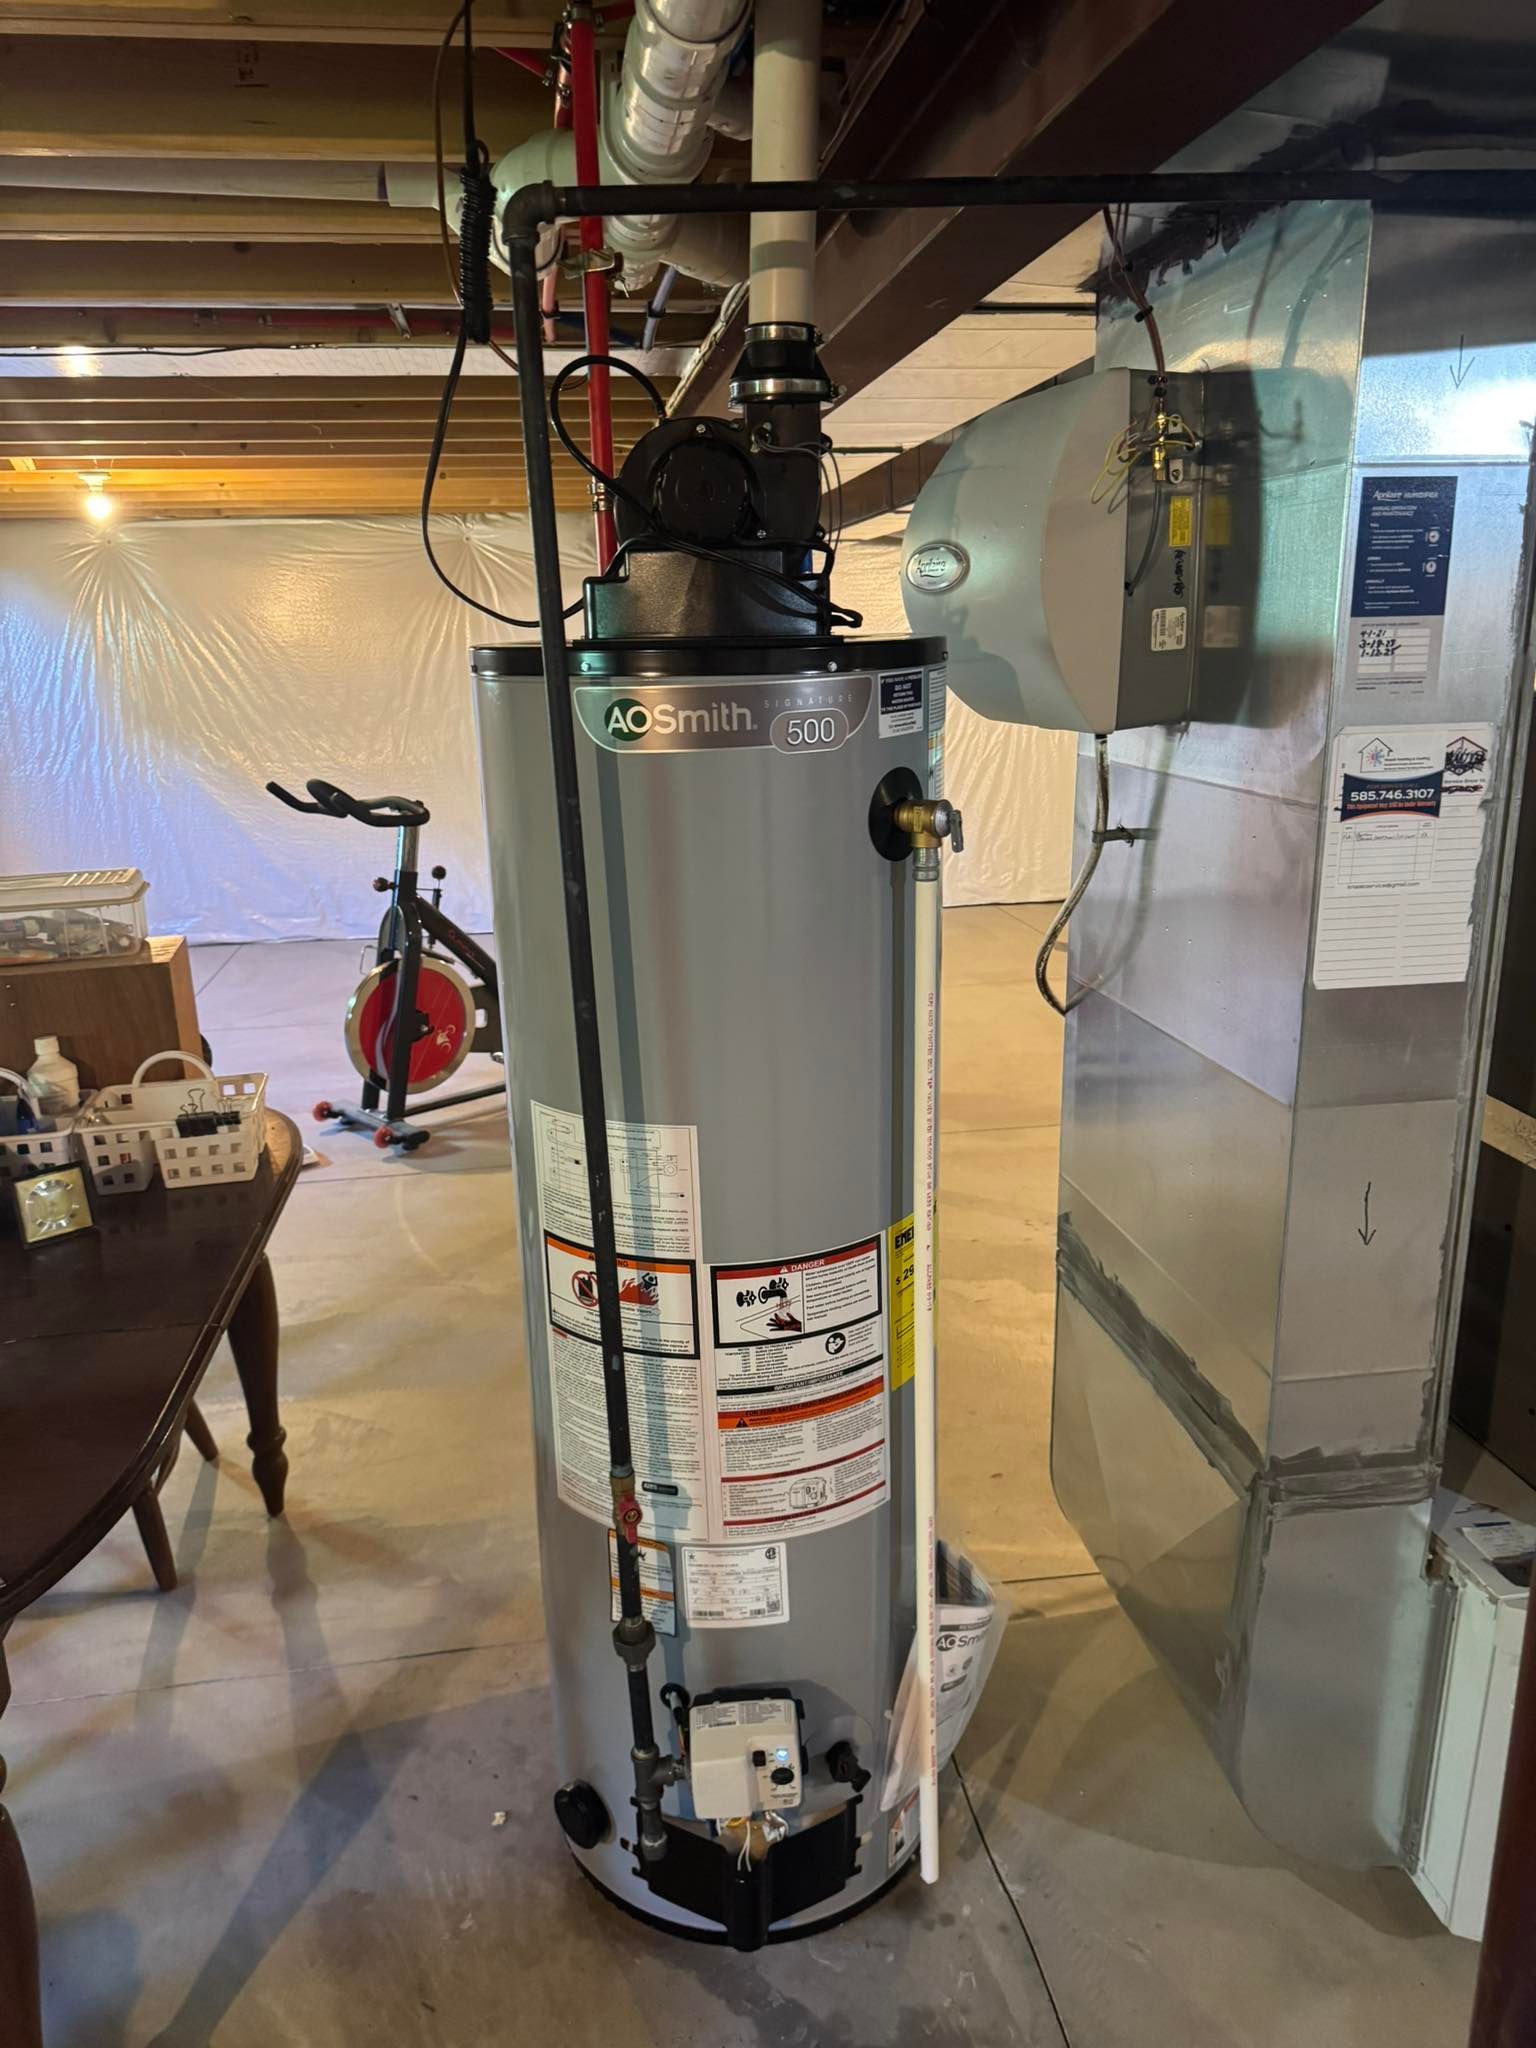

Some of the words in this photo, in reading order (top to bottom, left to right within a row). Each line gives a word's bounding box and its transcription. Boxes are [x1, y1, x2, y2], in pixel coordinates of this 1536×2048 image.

[764, 694, 853, 708] SIGNATURE
[786, 717, 835, 745] 500
[1350, 788, 1435, 802] 585.746.3107
[791, 1259, 825, 1272] DANGER
